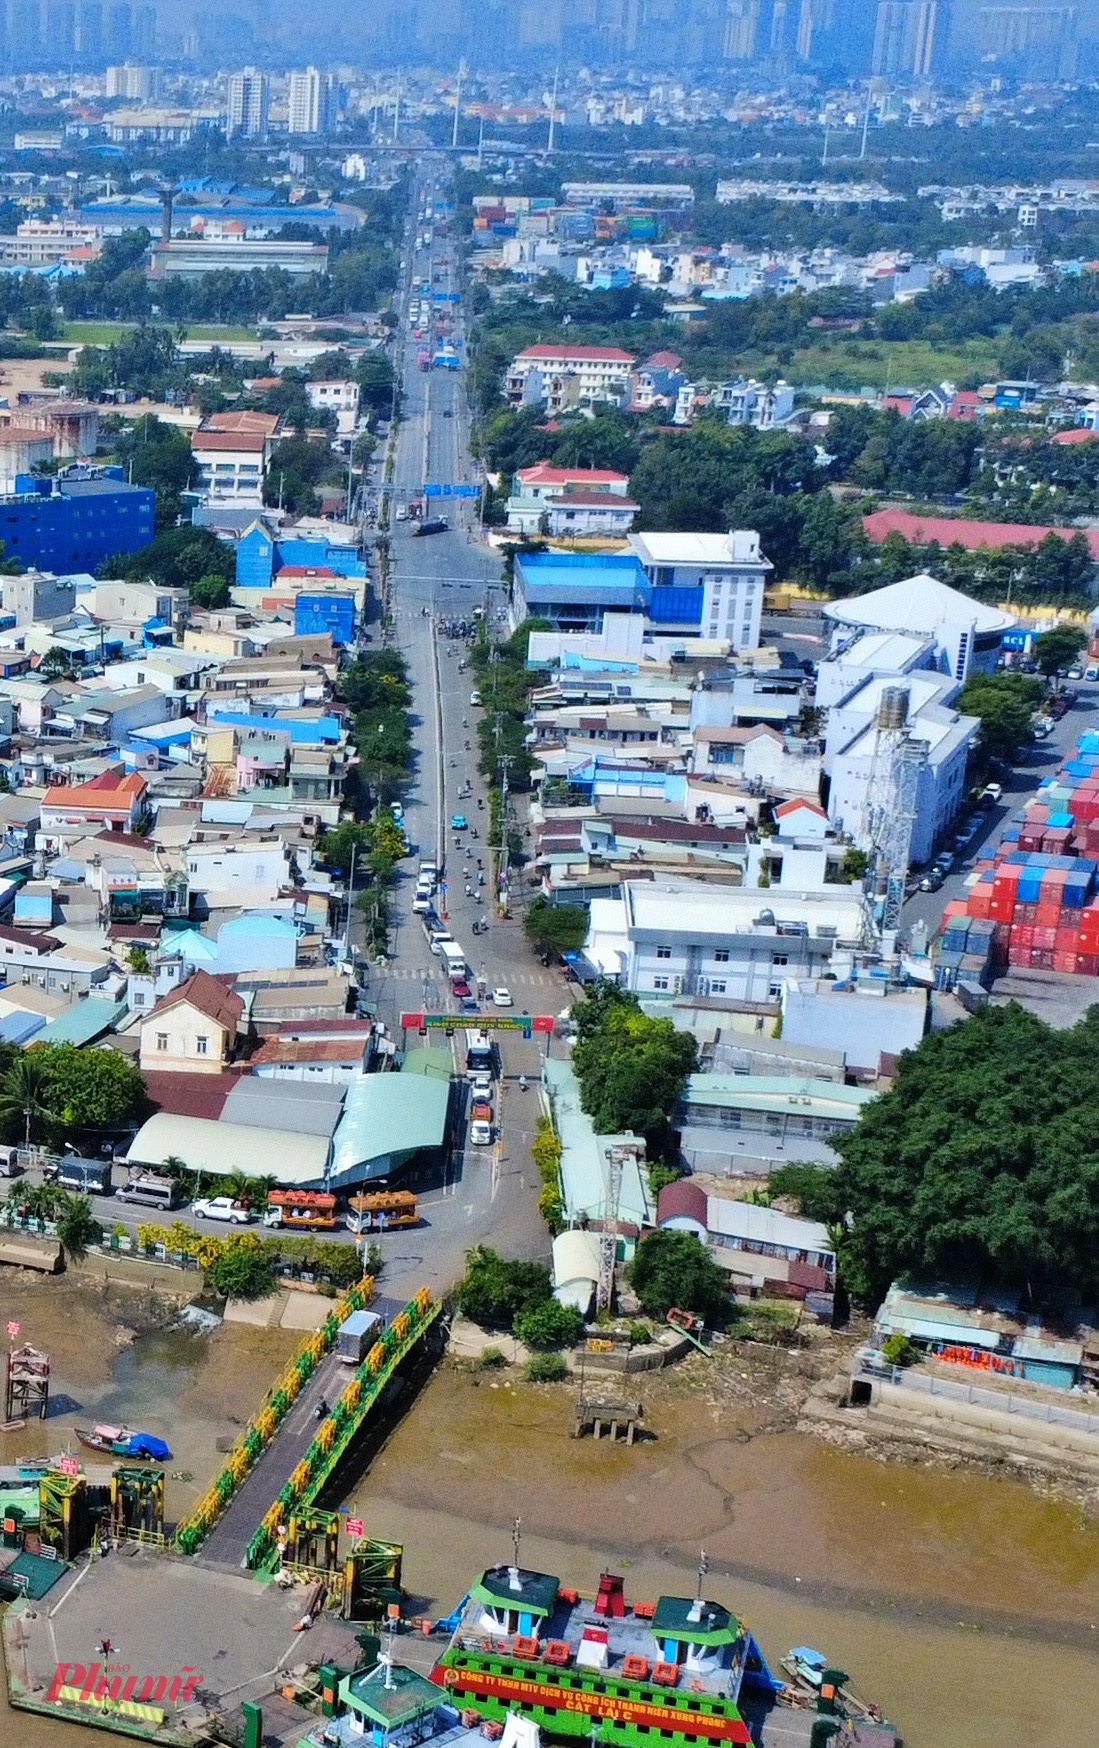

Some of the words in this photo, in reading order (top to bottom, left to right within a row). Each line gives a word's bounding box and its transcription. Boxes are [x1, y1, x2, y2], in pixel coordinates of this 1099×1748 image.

[460, 1670, 484, 1683] CÔNG
[485, 1675, 496, 1685] TY
[520, 1682, 538, 1693] MTV
[617, 1700, 646, 1714] THANH
[669, 1710, 695, 1723] XUNG
[696, 1714, 727, 1728] PHONG
[622, 1711, 633, 1720] C
